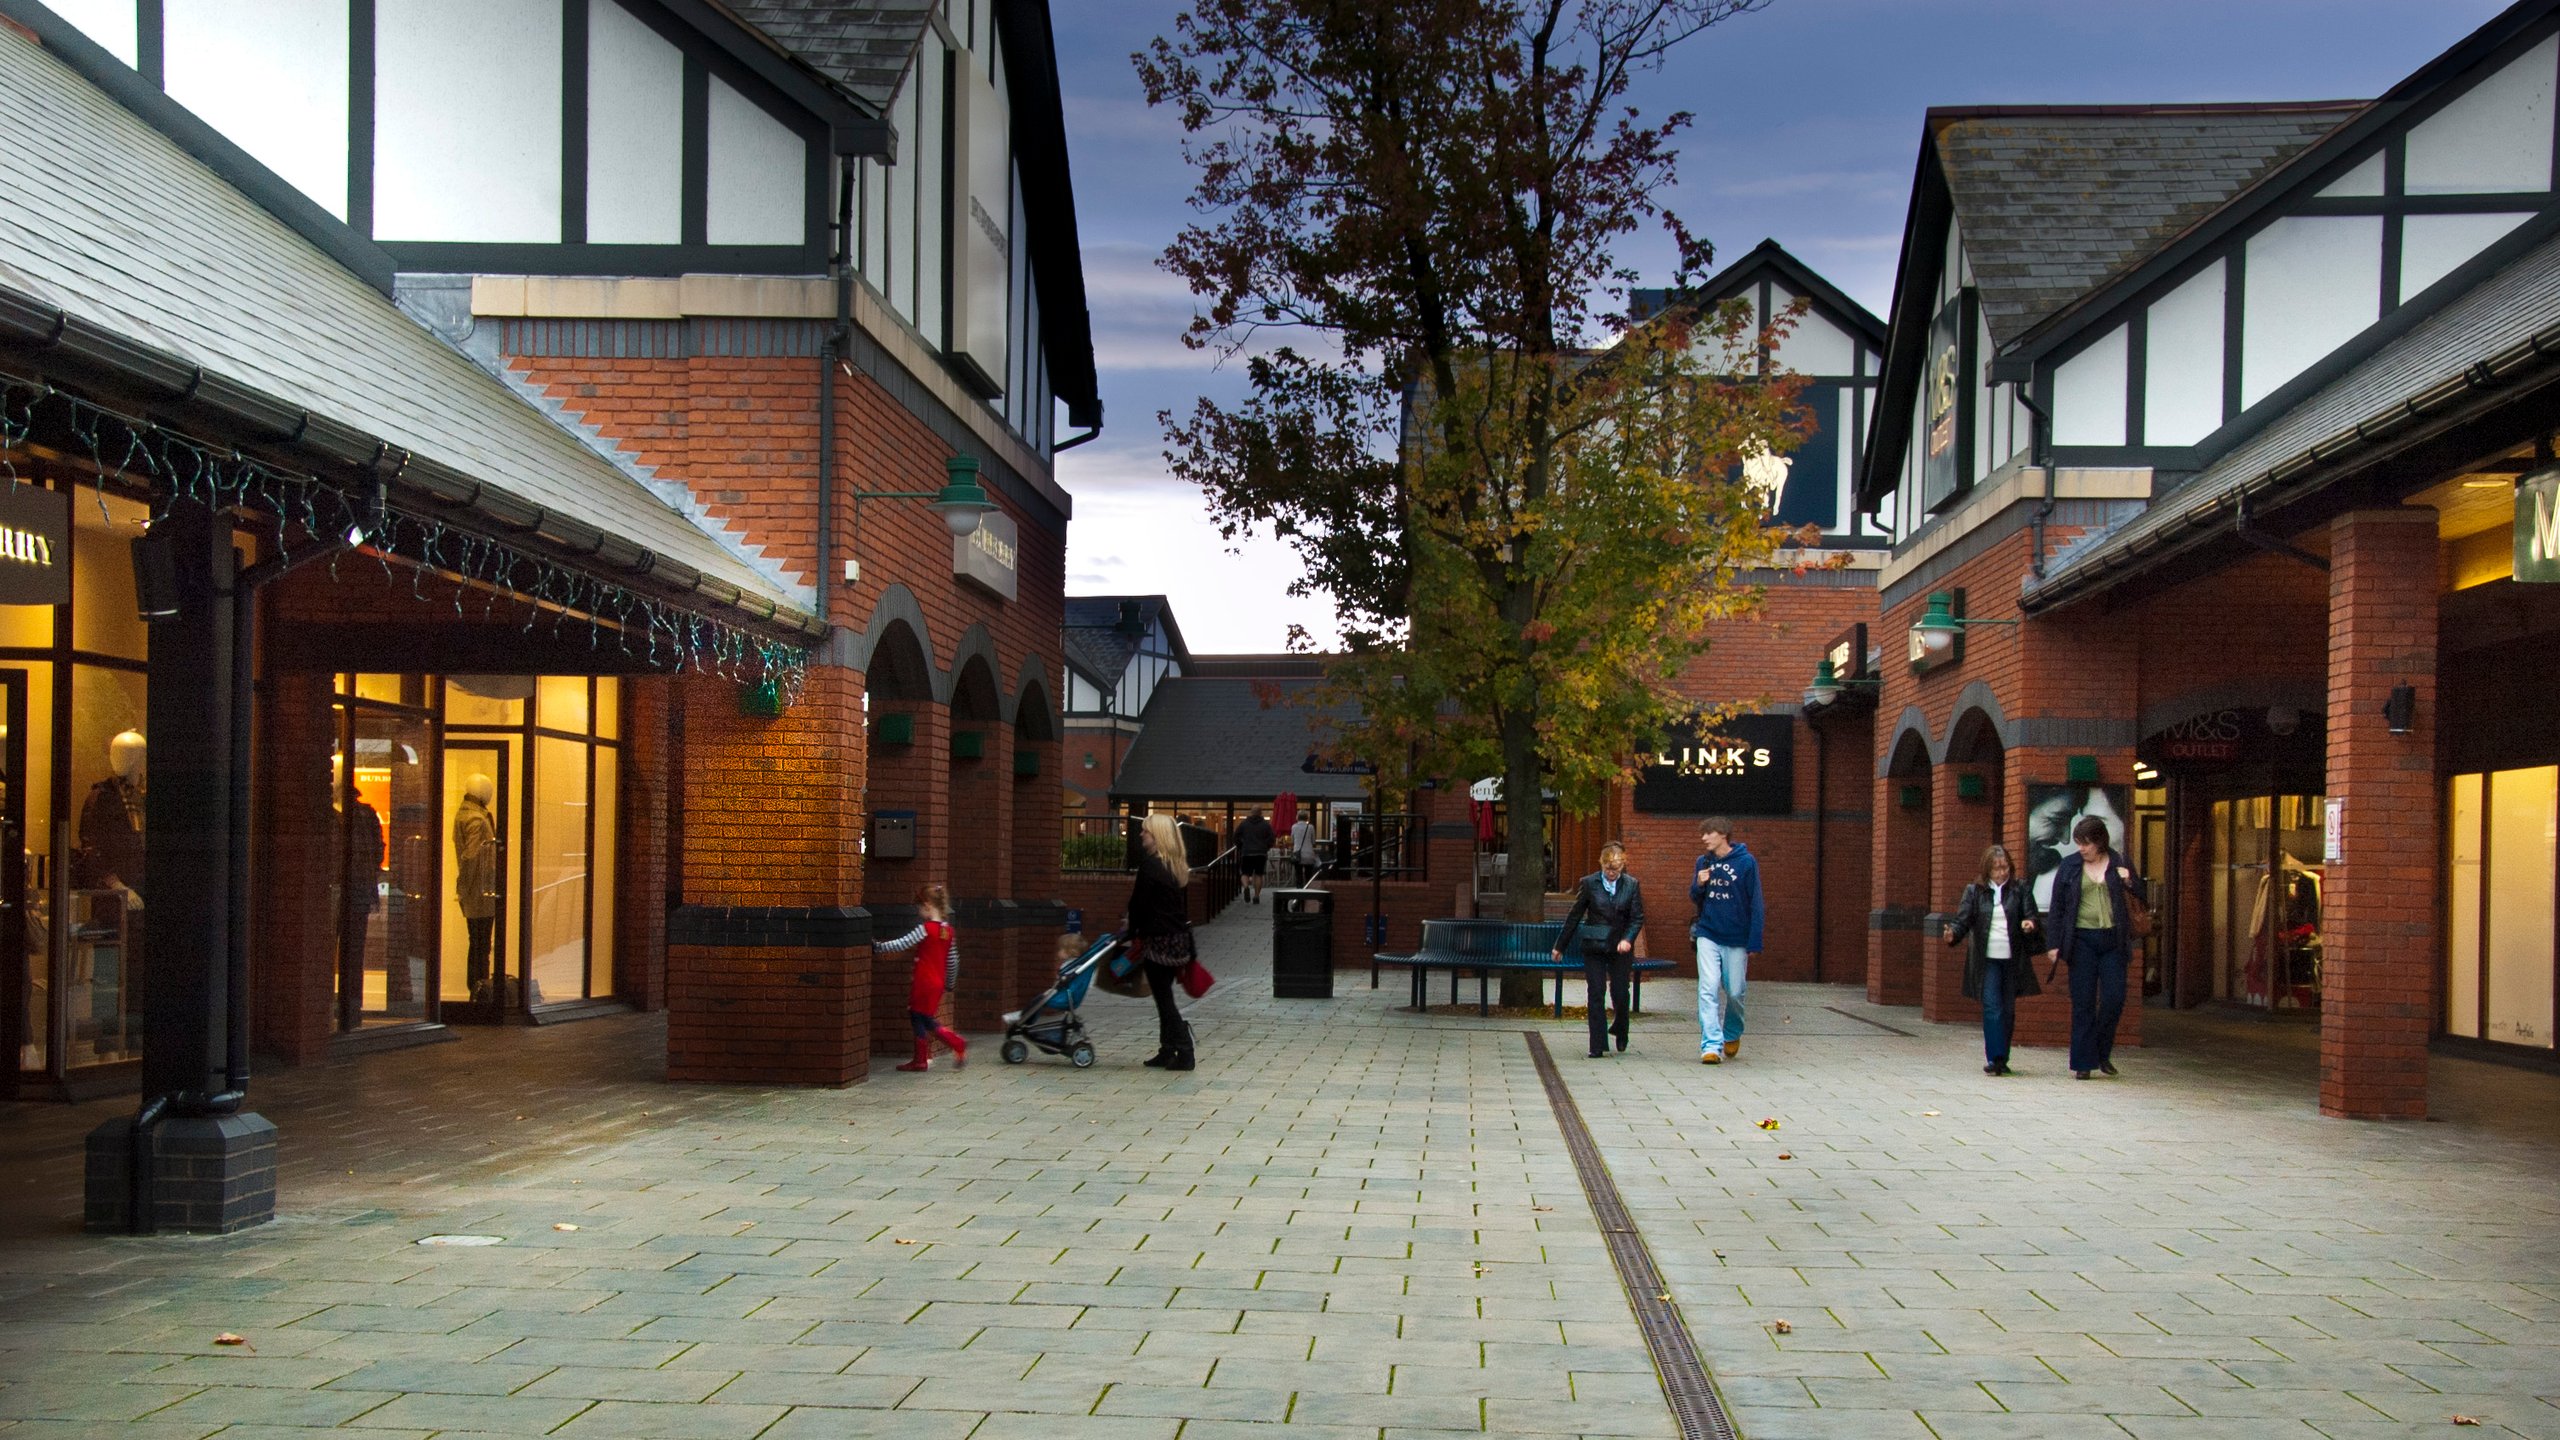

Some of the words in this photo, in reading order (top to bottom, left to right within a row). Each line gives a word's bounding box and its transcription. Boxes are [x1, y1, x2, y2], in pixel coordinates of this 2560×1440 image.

[2164, 711, 2240, 741] M&S
[1658, 748, 1771, 767] LINKS
[2172, 744, 2230, 758] OUTLET
